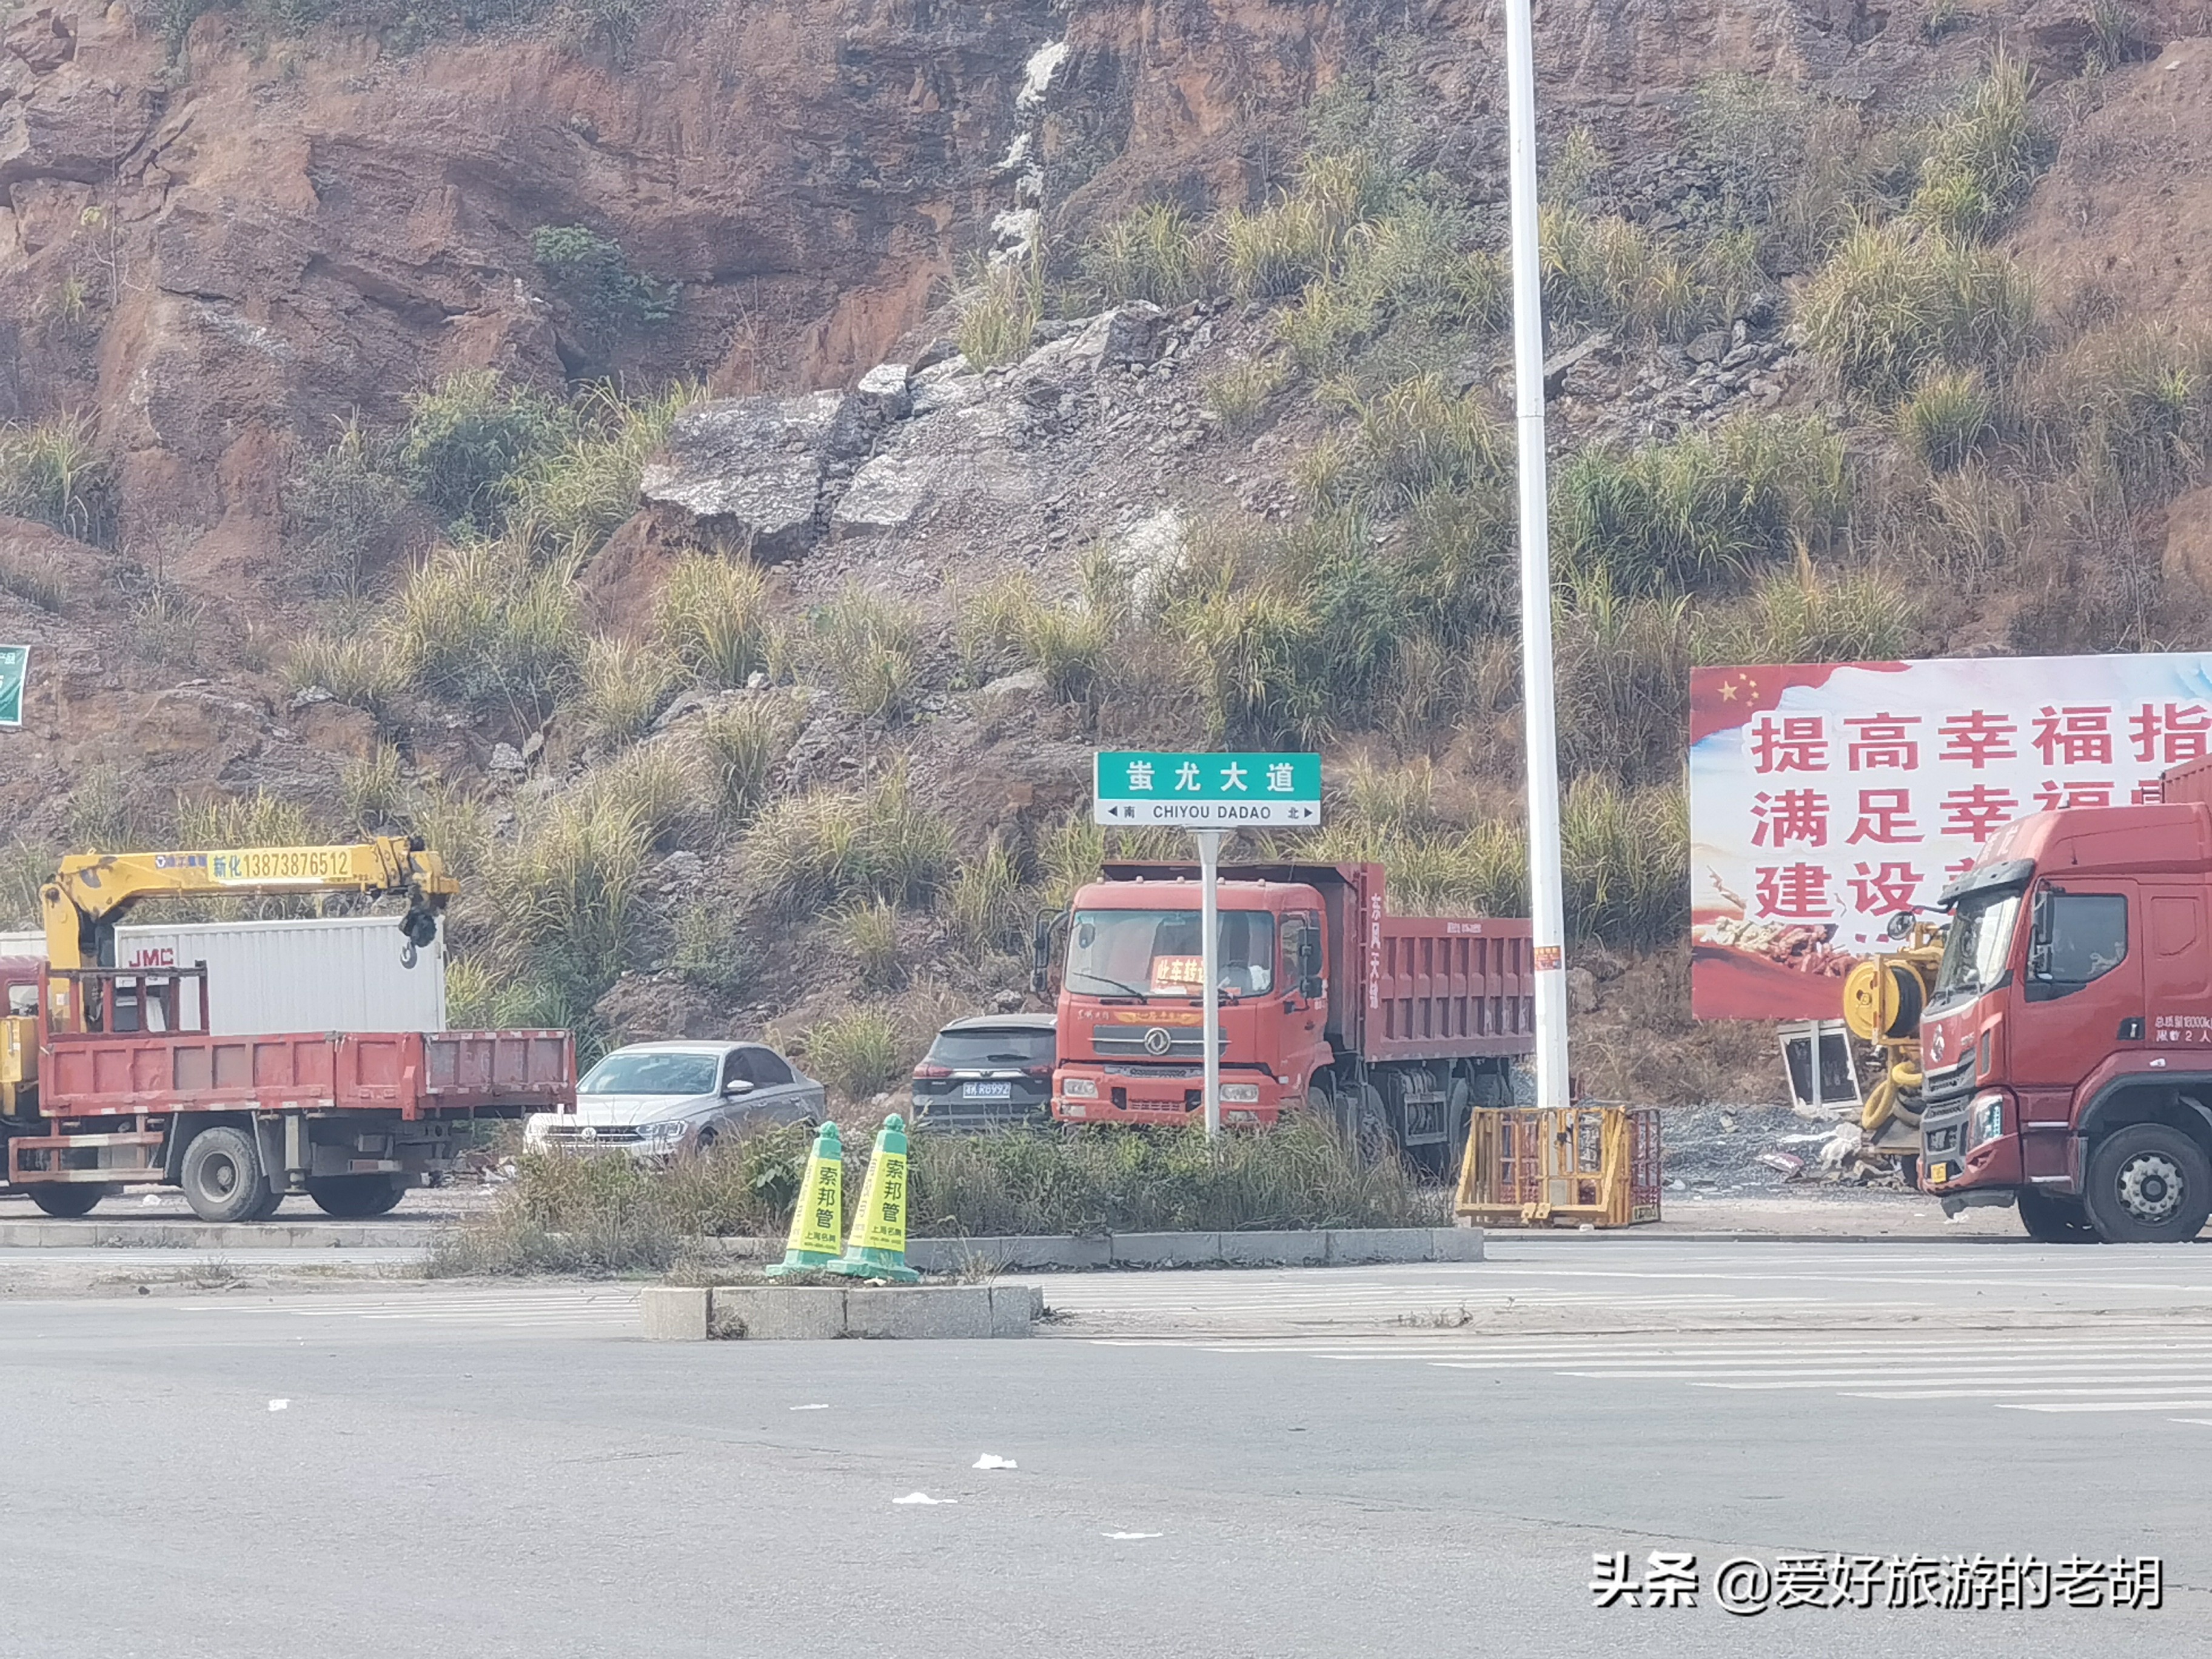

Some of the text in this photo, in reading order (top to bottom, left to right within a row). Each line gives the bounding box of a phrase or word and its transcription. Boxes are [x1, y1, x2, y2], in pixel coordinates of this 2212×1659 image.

[1751, 703, 2212, 773] 提高幸福指
[1126, 760, 1295, 792] 蚩尤大道
[1124, 805, 1299, 819] 南 CHIYOU DADAO 北
[213, 854, 242, 877] 新化
[244, 851, 348, 877] 13873876512
[1755, 857, 1980, 919] 建设
[129, 948, 174, 967] JMC
[816, 1166, 838, 1229] 索邦管
[882, 1159, 904, 1223] 索邦管
